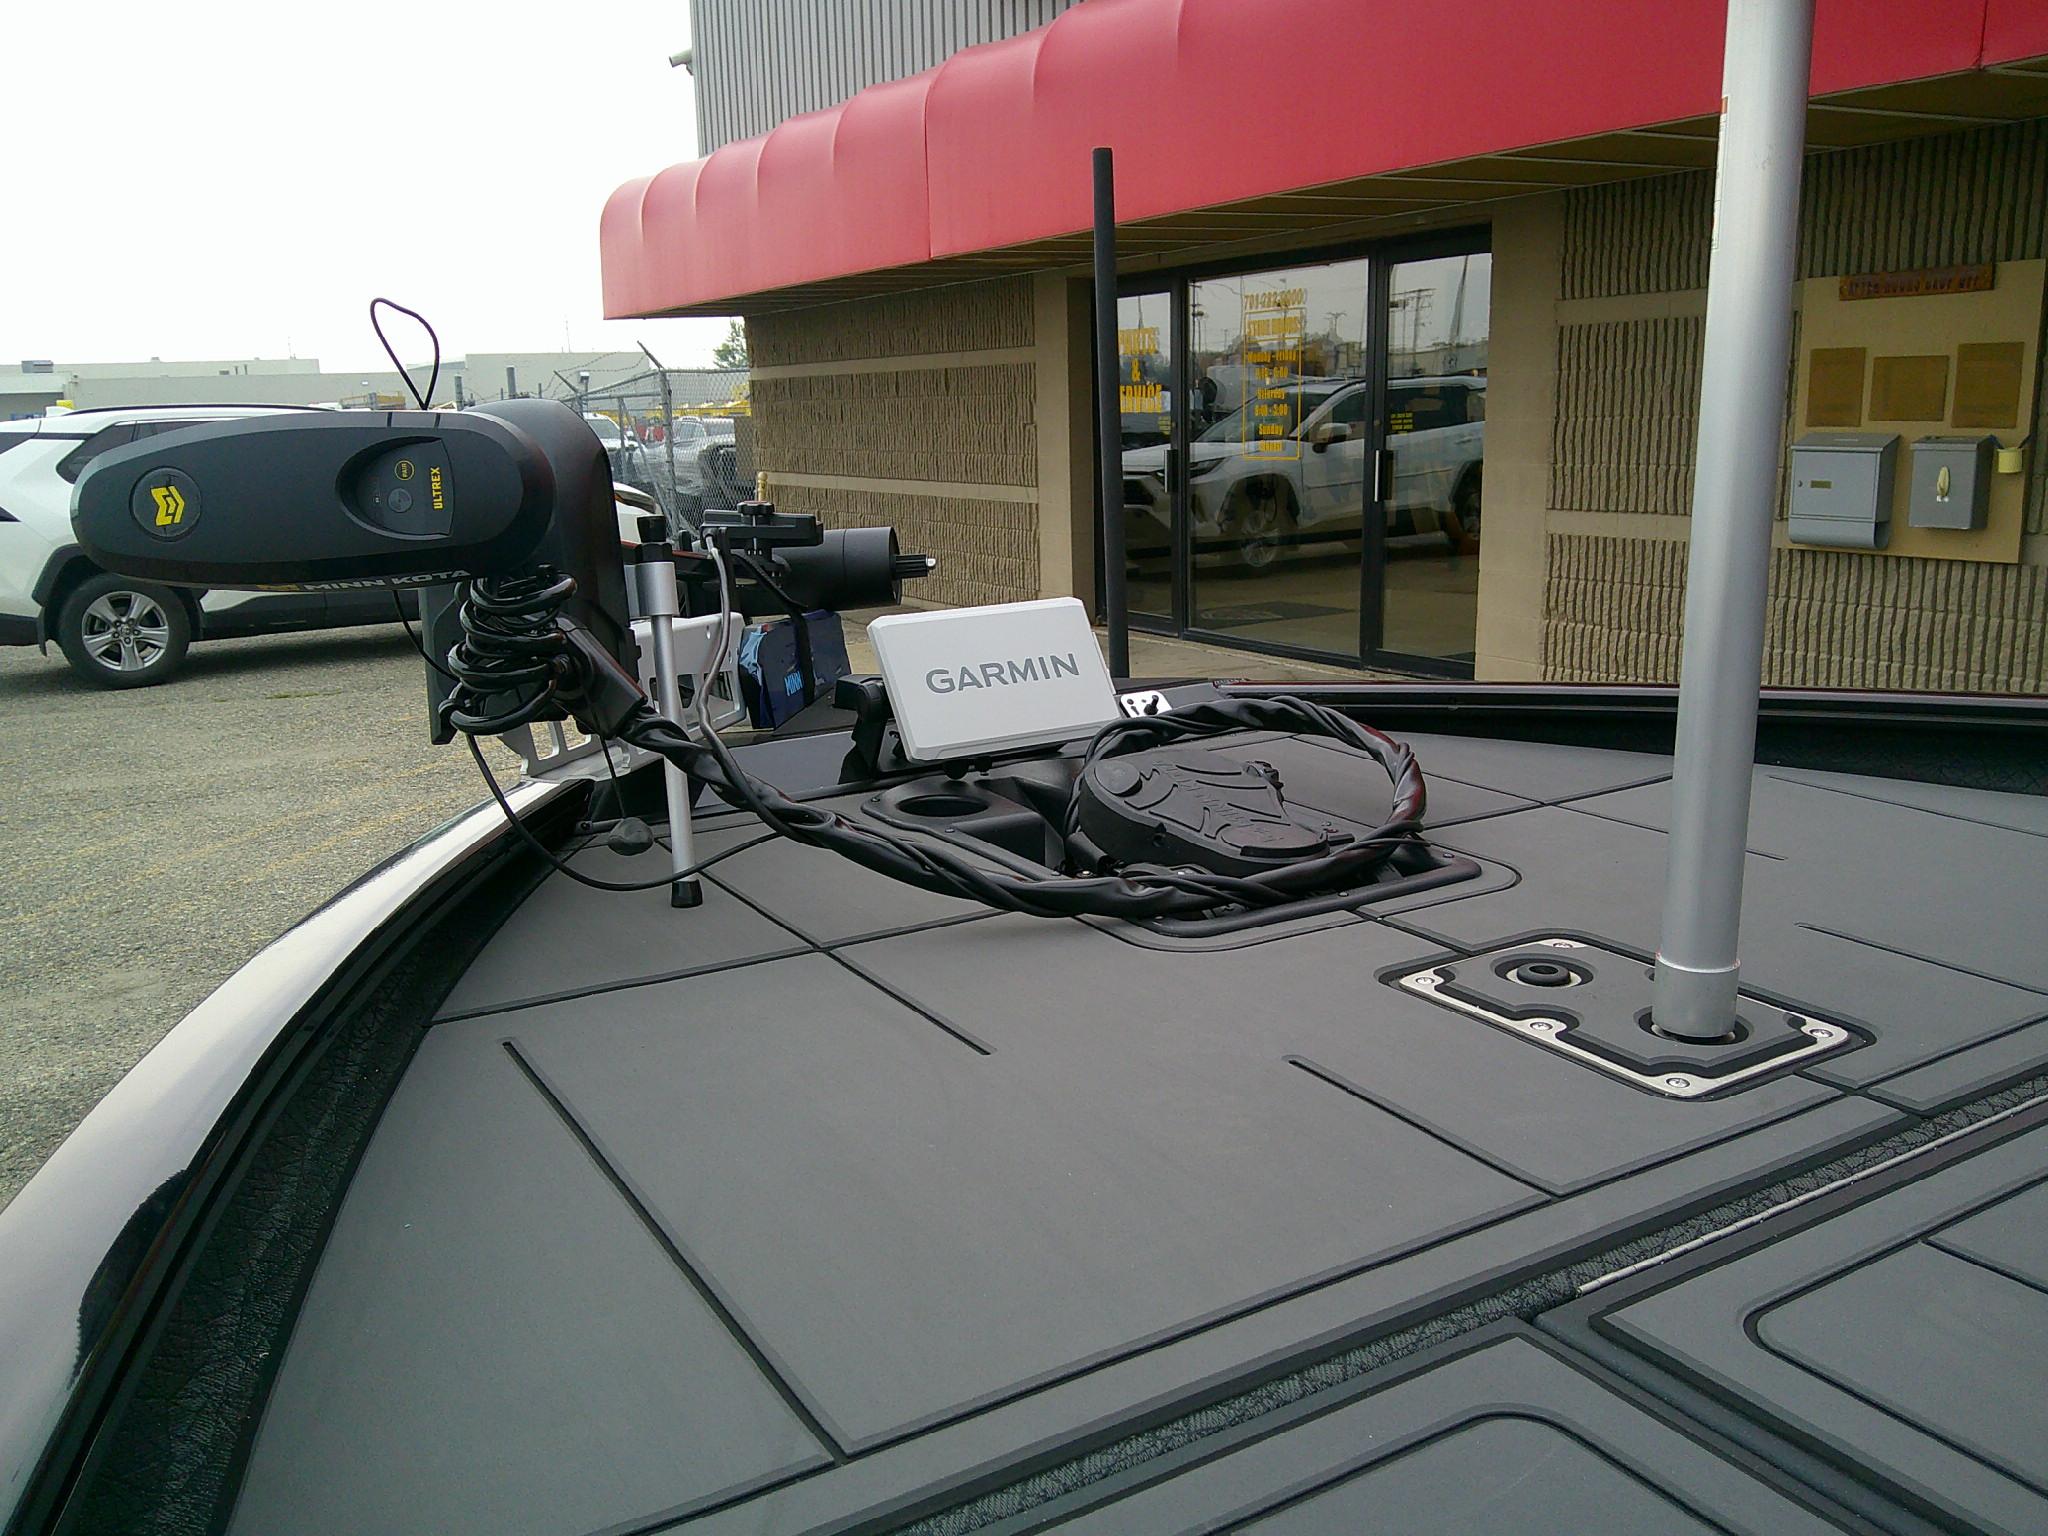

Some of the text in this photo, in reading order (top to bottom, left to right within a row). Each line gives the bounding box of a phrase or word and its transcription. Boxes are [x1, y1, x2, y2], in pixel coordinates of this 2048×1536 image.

[1131, 358, 1141, 382] &
[1119, 384, 1163, 413] ERVICE
[1259, 423, 1284, 436] Sunday
[430, 467, 443, 510] ULTREX
[303, 569, 472, 592] MINN KOTA
[783, 670, 803, 697] MINN
[925, 652, 1080, 694] GARMIN
